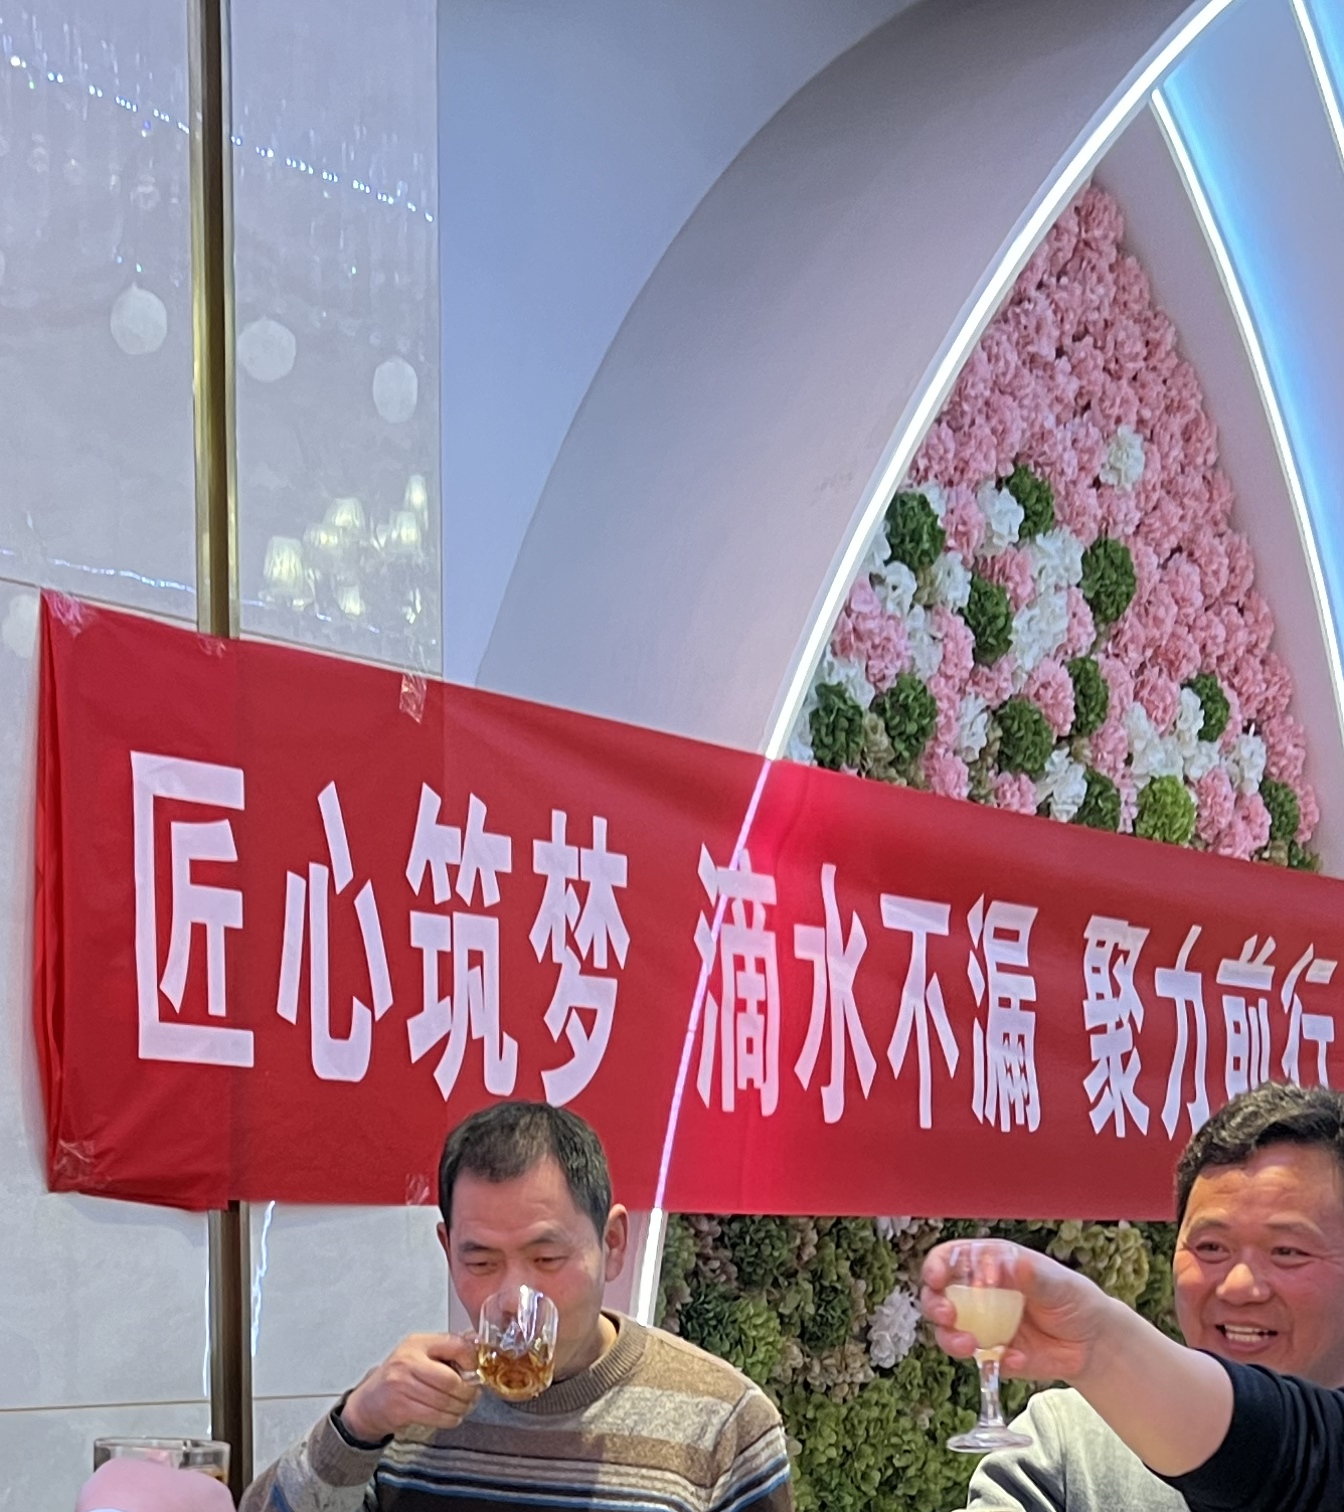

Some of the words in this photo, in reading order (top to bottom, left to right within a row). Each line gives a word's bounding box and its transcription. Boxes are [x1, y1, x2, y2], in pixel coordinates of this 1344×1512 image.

[130, 750, 631, 1108] 匠心筑梦
[693, 842, 1041, 1133] 滴水不漏
